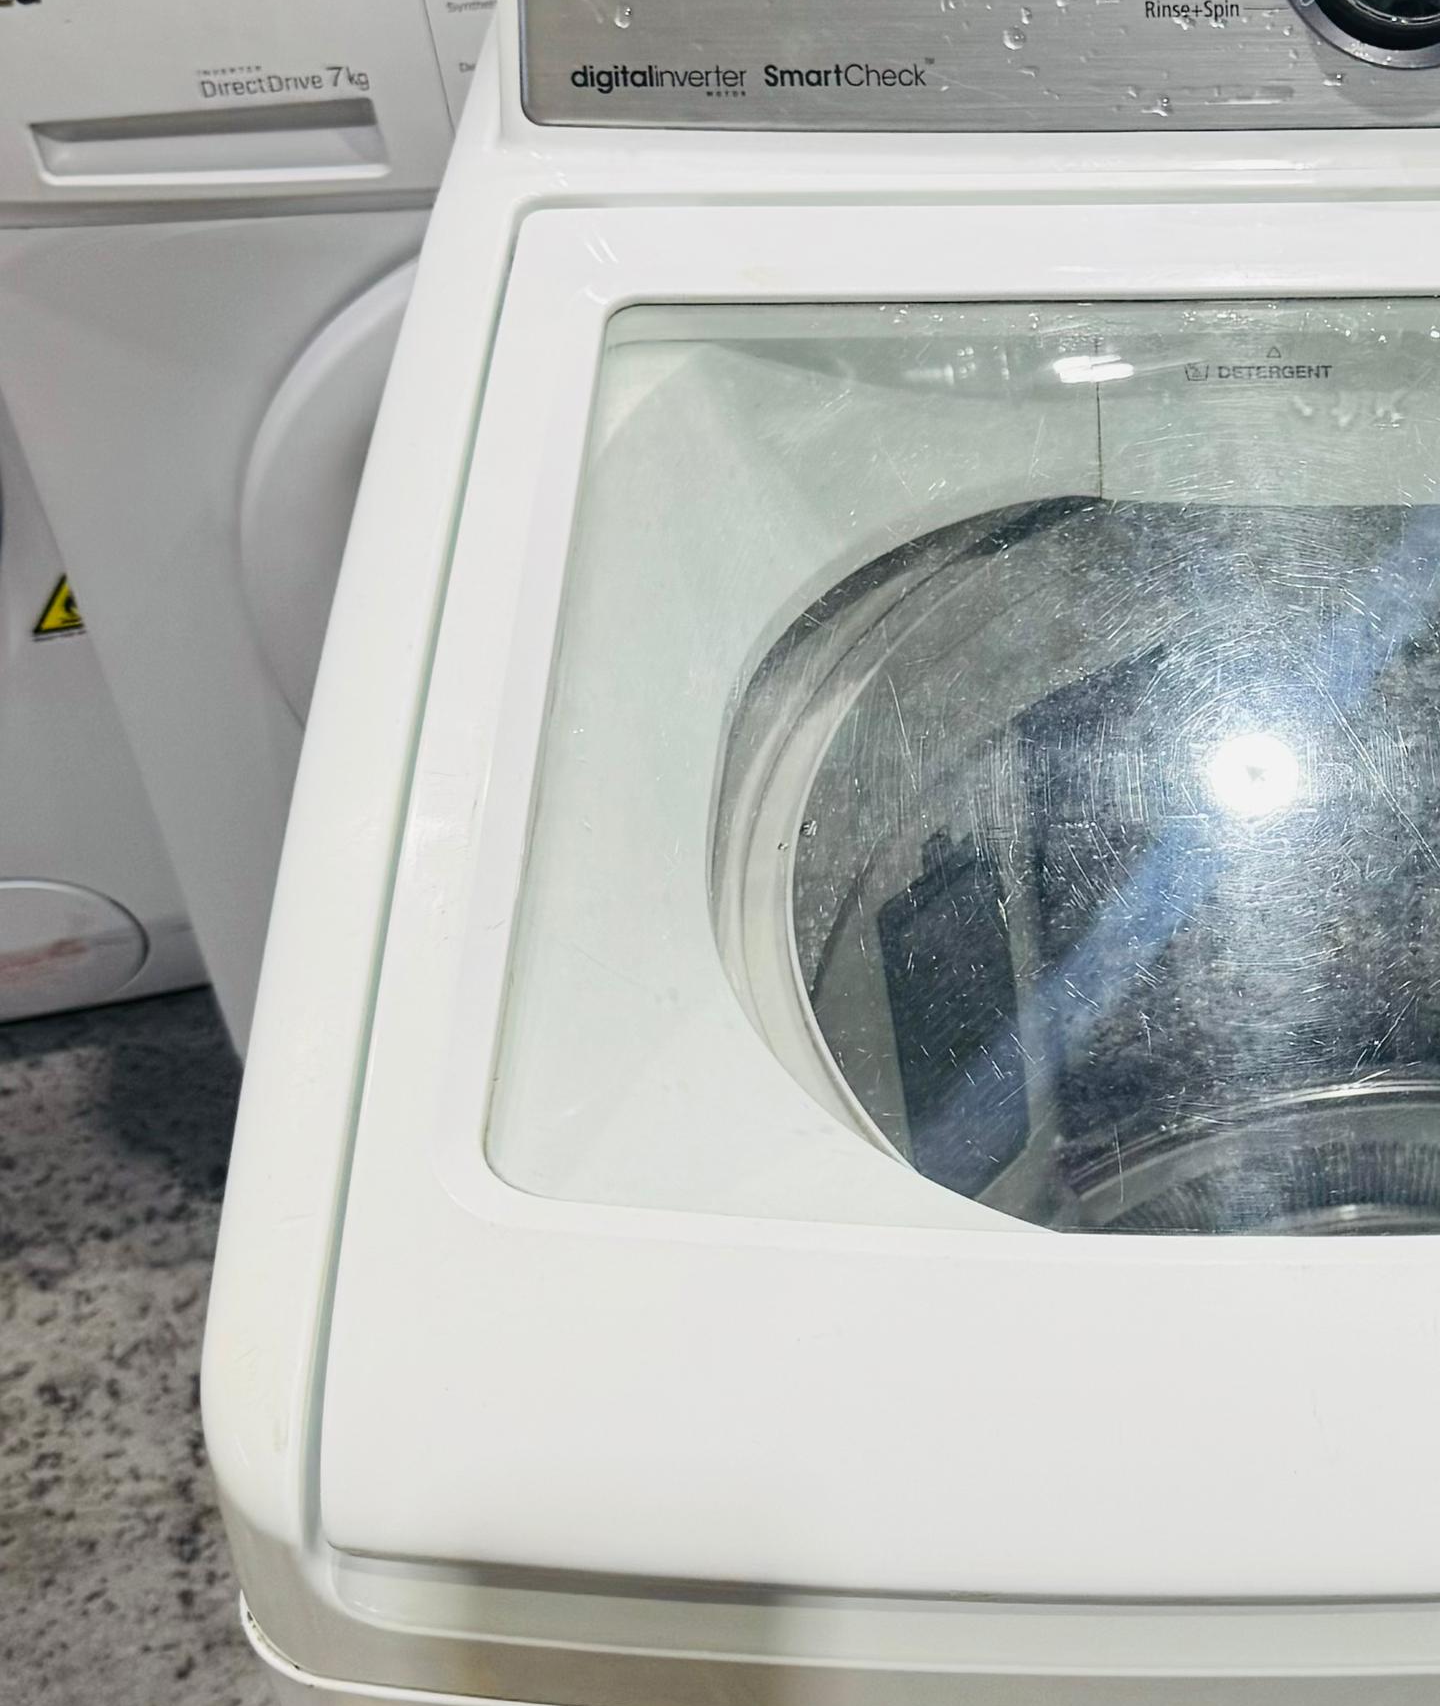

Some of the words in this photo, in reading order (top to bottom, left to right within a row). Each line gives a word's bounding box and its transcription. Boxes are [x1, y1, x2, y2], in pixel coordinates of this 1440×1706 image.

[1144, 0, 1241, 23] Rinse+Spin
[570, 64, 747, 94] digitalinverter
[1217, 364, 1333, 380] DETERGENT
